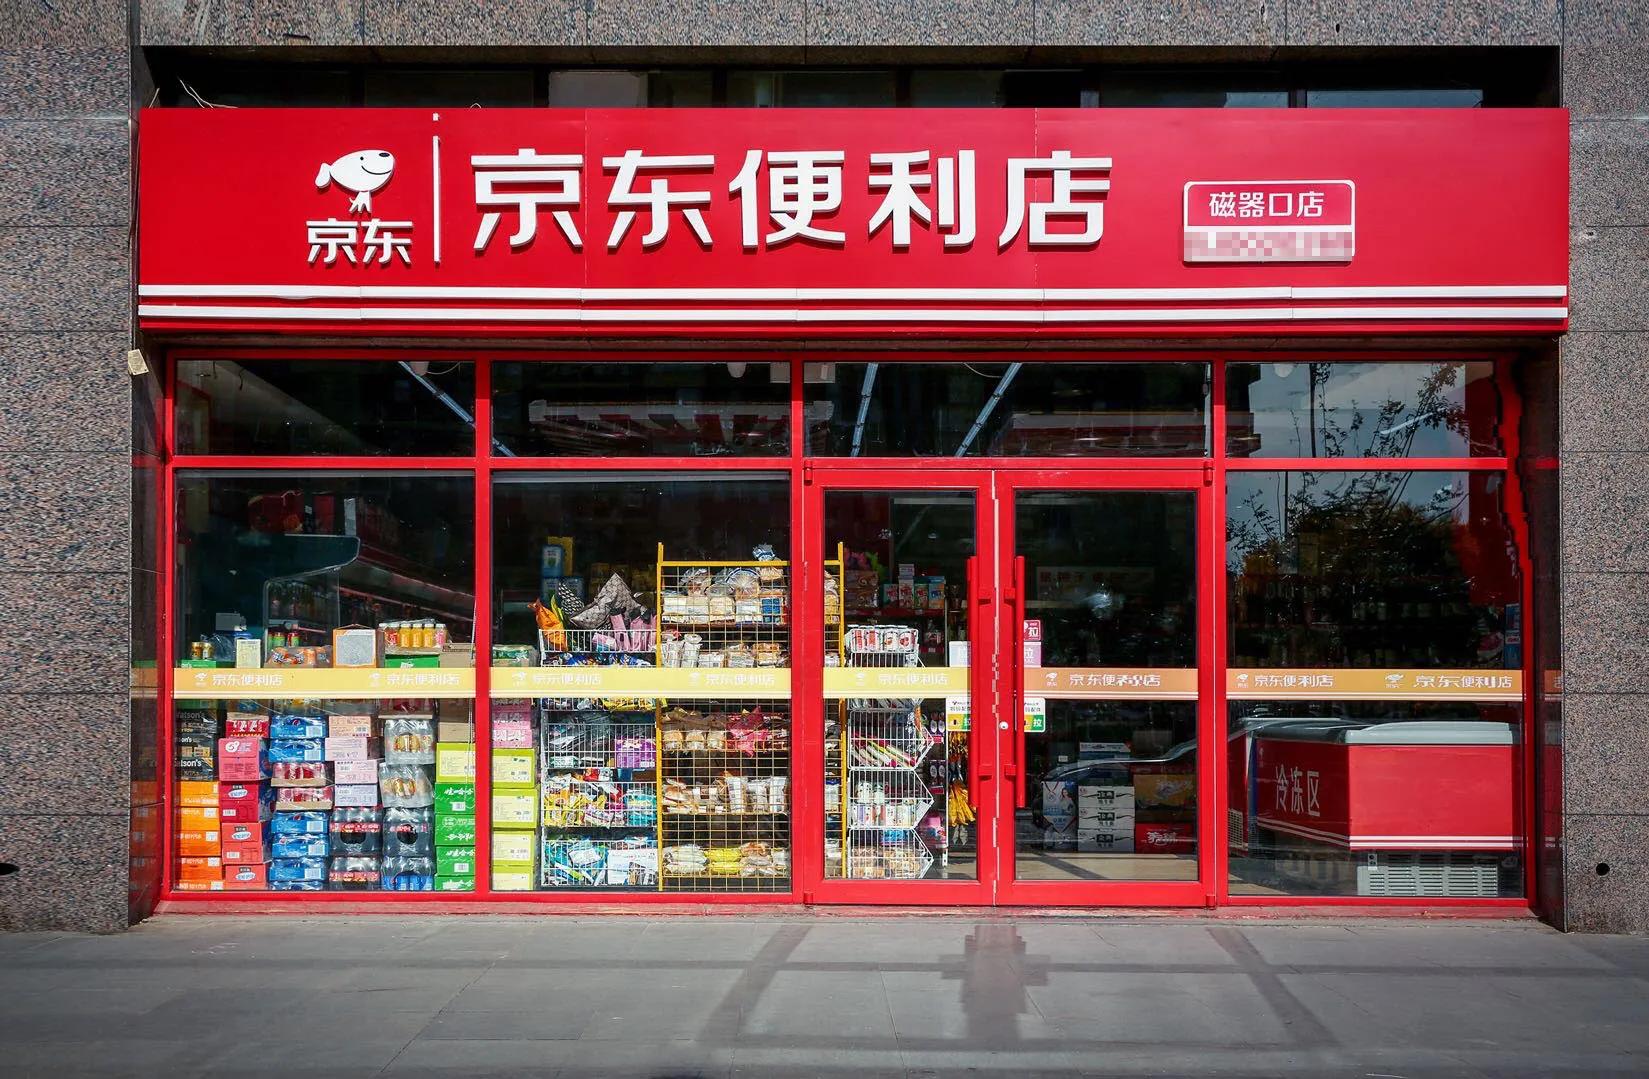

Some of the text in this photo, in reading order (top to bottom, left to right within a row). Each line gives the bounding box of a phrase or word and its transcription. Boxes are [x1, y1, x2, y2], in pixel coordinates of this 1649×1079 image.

[470, 148, 1113, 249] 京东便利店
[1208, 190, 1325, 219] 磁器口店
[306, 218, 414, 264] 京东
[212, 673, 284, 686] 京东便利店
[1069, 673, 1161, 687] 京东便利店
[1254, 674, 1334, 688] 京东便利店
[1413, 674, 1513, 688] 京东便利店
[1275, 764, 1321, 817] 冷冻区
